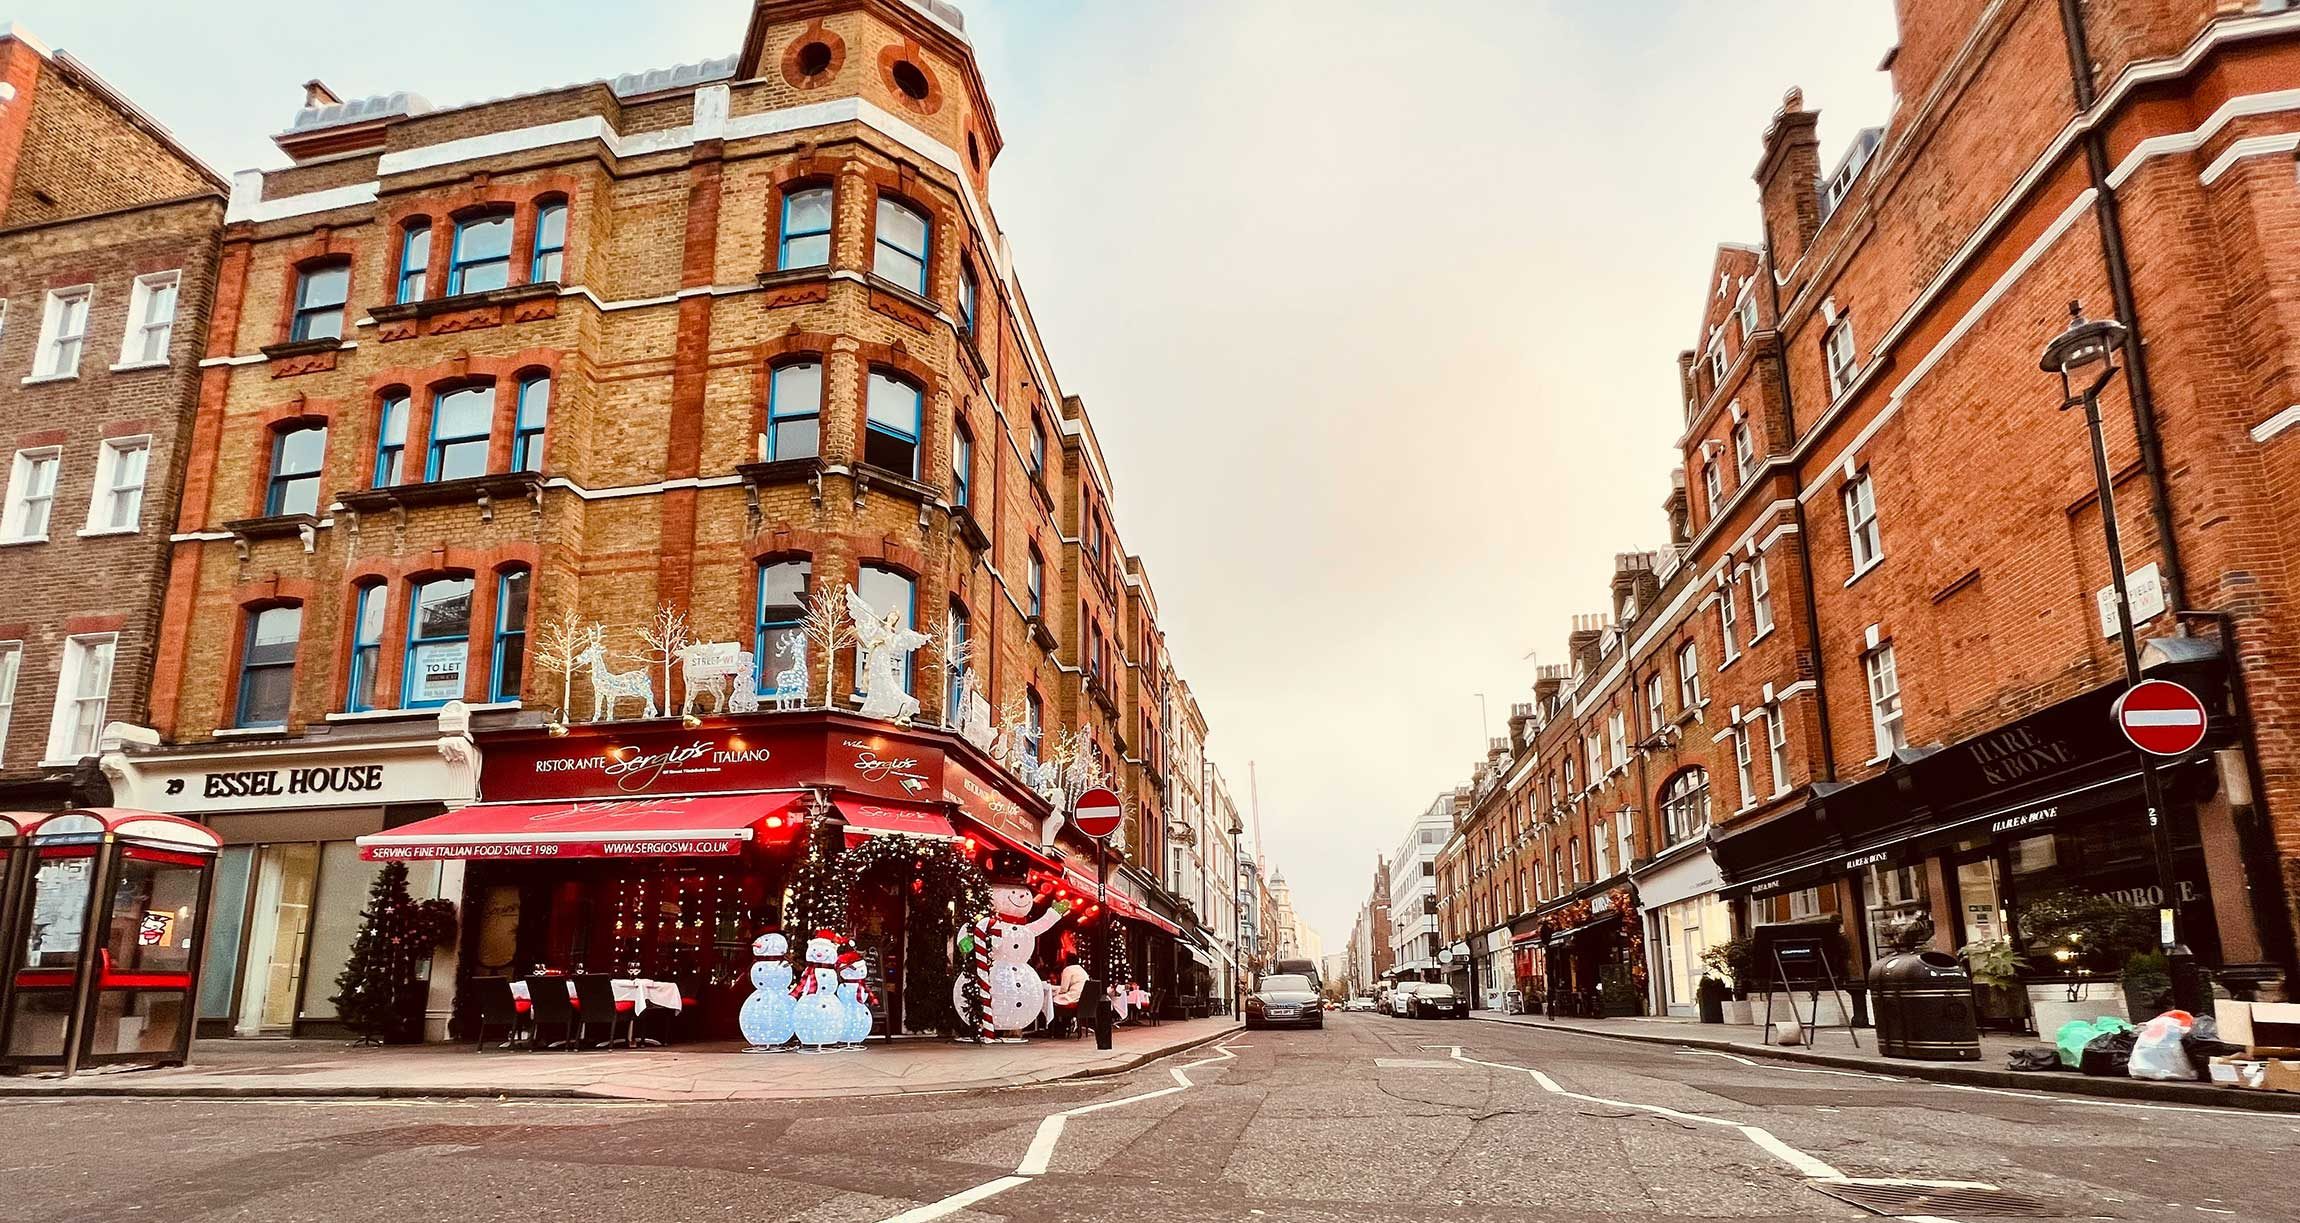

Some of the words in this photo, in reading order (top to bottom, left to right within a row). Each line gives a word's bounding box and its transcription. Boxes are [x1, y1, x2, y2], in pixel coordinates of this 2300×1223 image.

[426, 664, 440, 672] TO
[442, 662, 461, 671] LET
[1968, 726, 2041, 764] HARE
[535, 756, 606, 773] RISTORANTE
[604, 740, 715, 792] Sergio's
[713, 749, 770, 764] ITALIANO
[854, 752, 918, 782] Sergio's
[203, 770, 283, 798] ESSEL
[288, 765, 384, 794] HOUSE
[372, 848, 412, 858] SERVING
[413, 847, 434, 857] FINE
[436, 846, 472, 857] ITALIAN
[473, 845, 502, 856] FOOD
[504, 845, 532, 855] SINCE
[534, 844, 559, 856] 1989
[603, 841, 729, 855] WWW.SERGIOSW1.CO.UK
